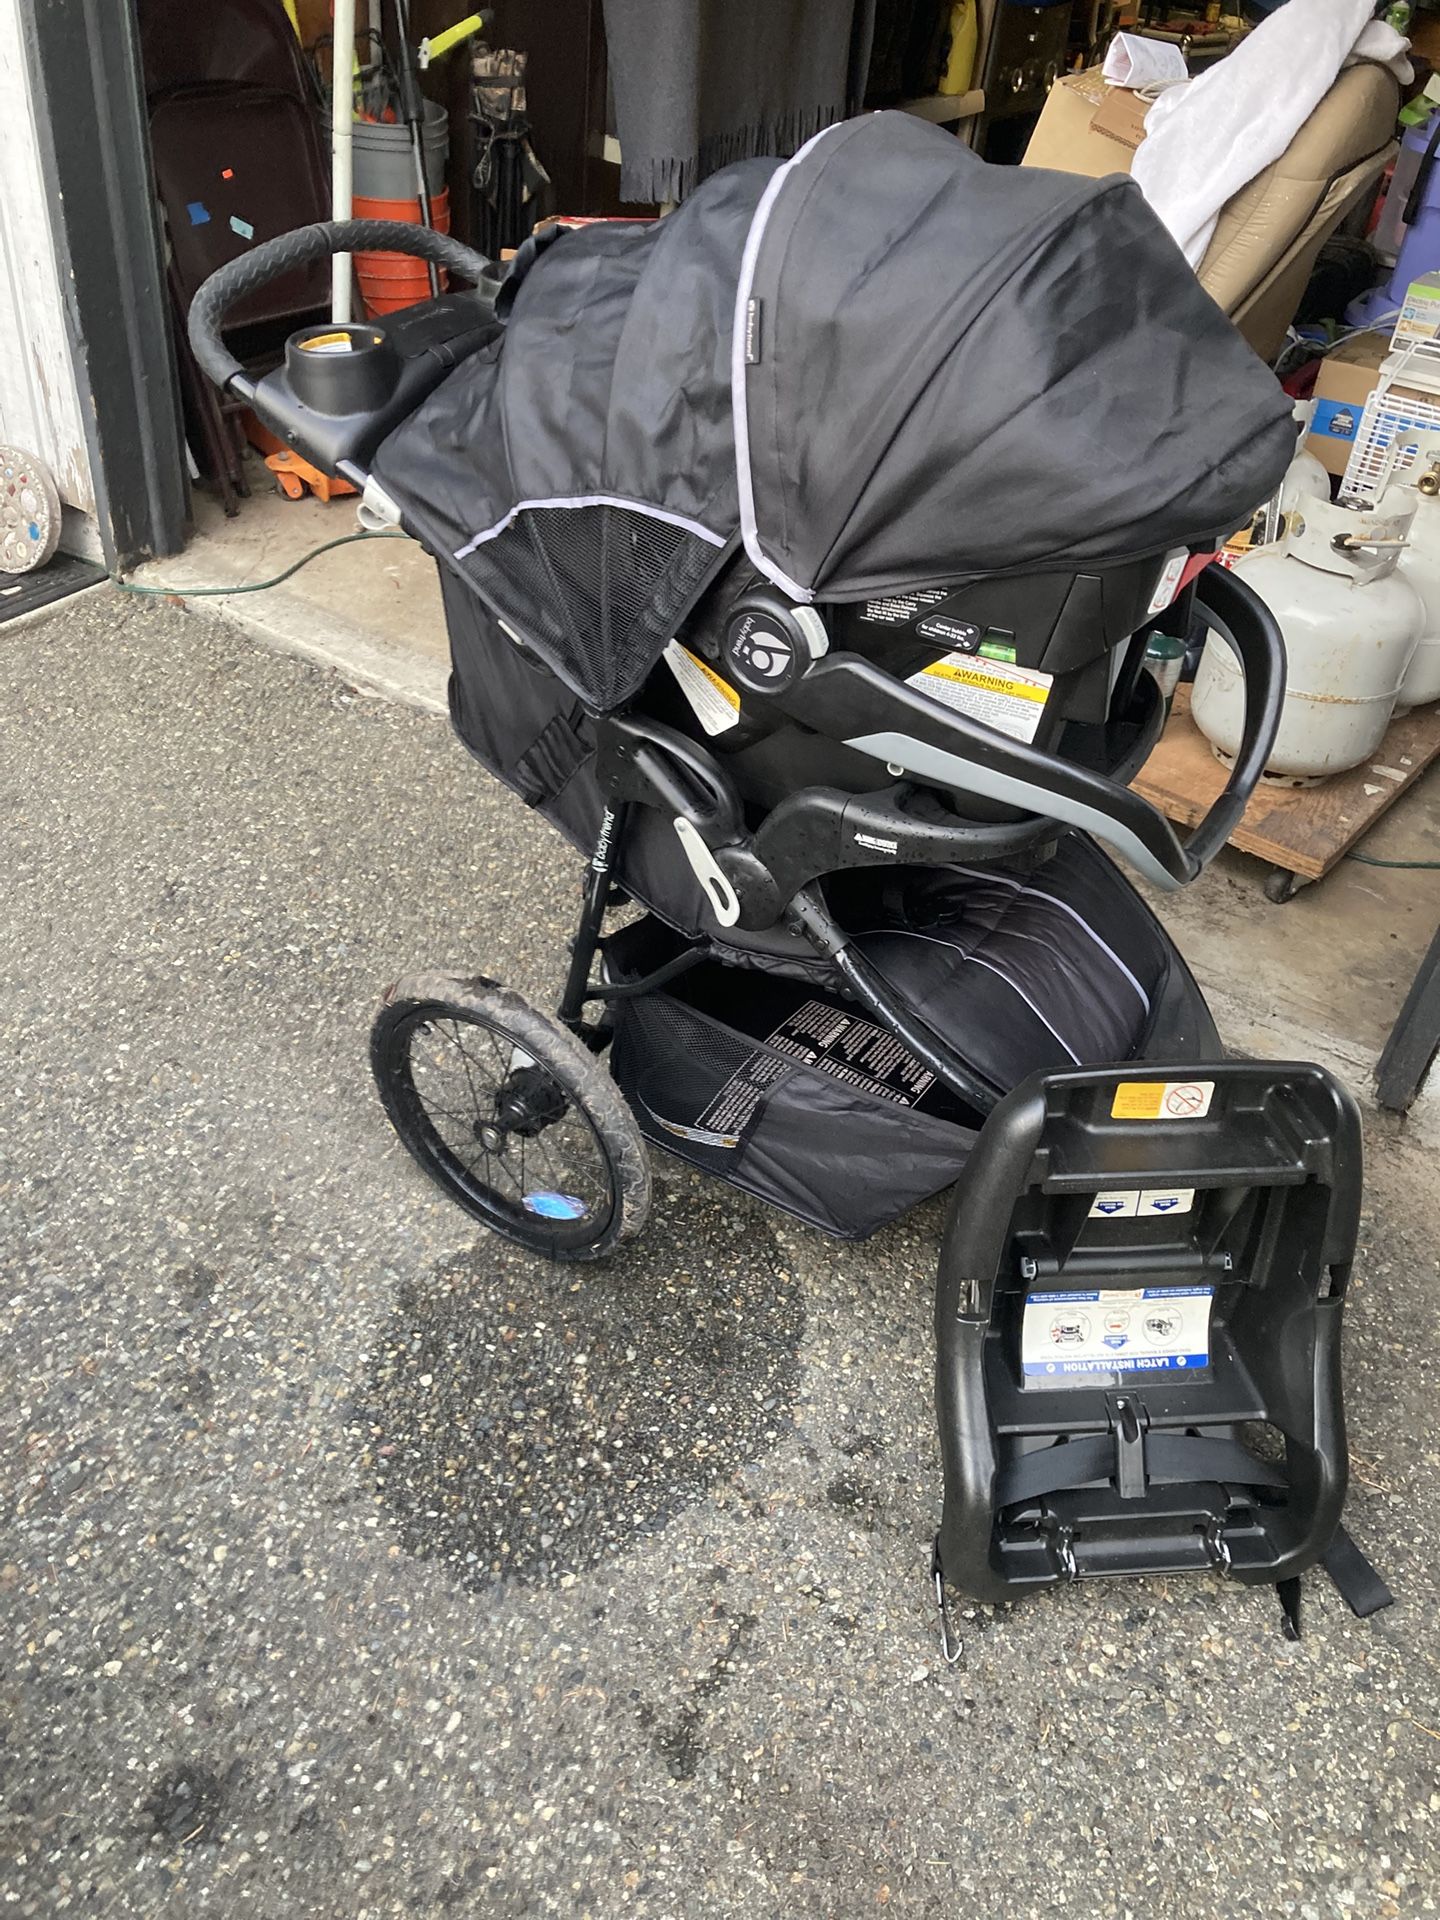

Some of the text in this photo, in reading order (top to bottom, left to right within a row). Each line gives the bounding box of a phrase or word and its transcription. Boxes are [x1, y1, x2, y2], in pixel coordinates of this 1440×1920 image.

[731, 616, 756, 657] babytrend
[962, 670, 1014, 690] WARNING
[594, 805, 615, 860] babytrend
[818, 1020, 849, 1049] WARNING
[910, 1070, 935, 1094] ARNING
[1063, 1356, 1170, 1372] LATCH INSTALLATION
